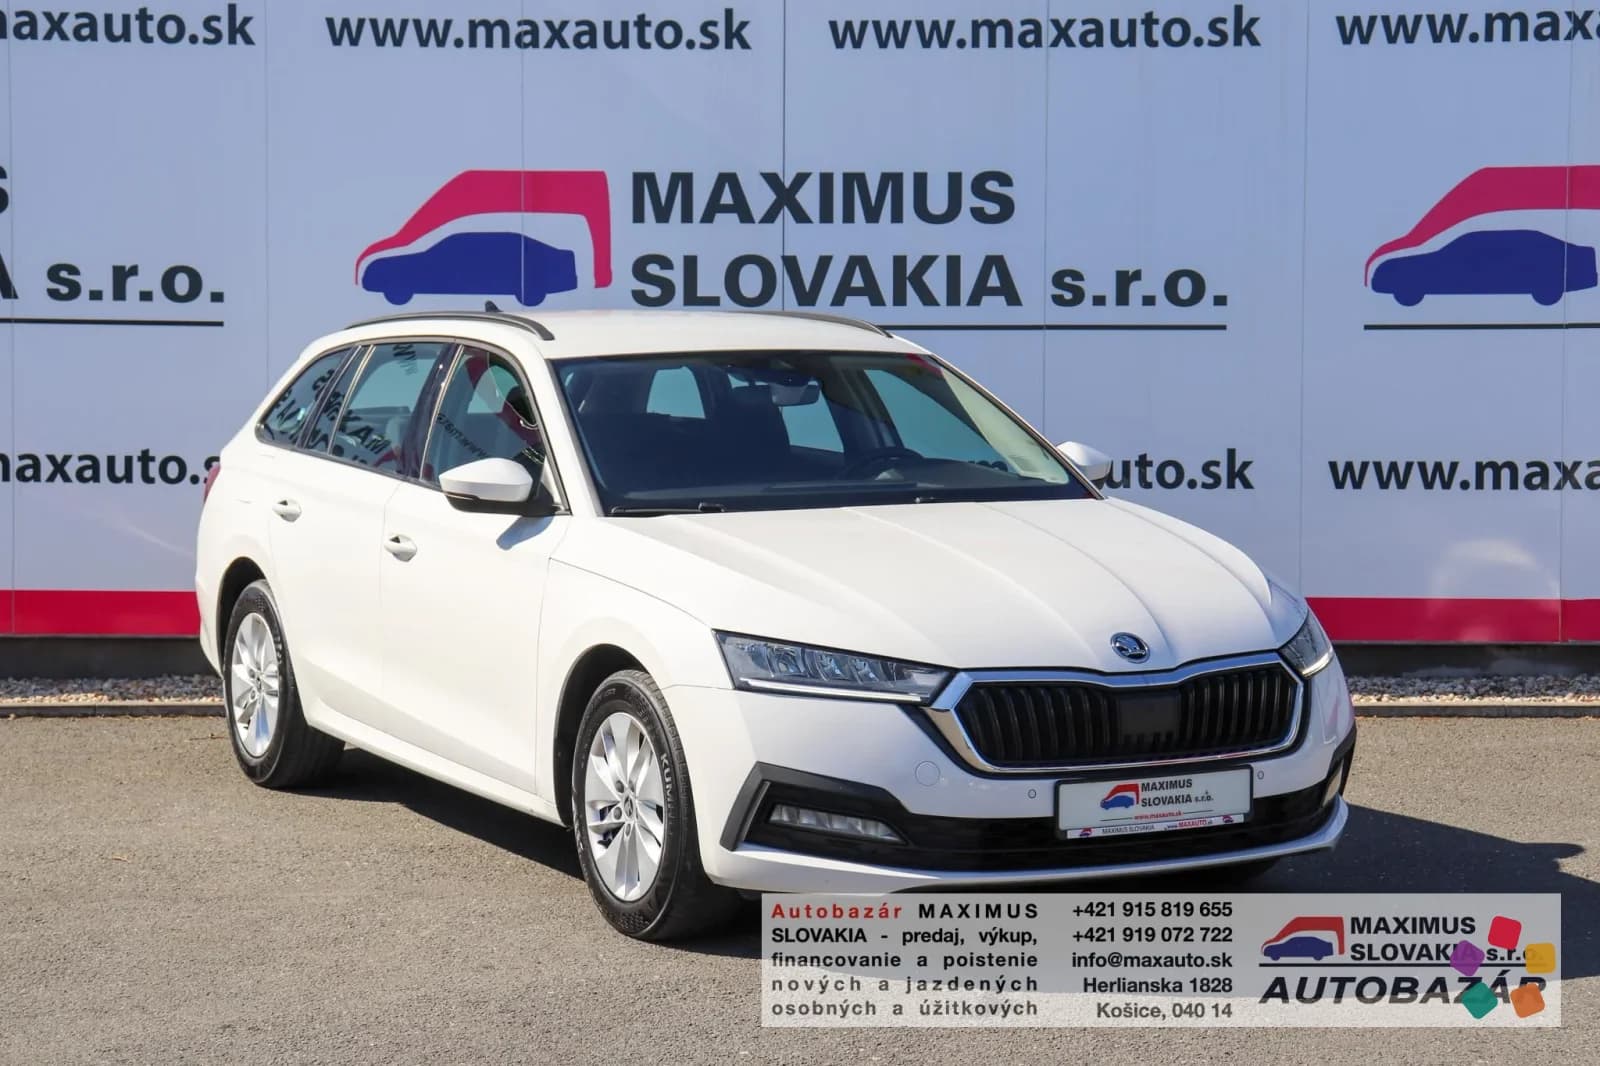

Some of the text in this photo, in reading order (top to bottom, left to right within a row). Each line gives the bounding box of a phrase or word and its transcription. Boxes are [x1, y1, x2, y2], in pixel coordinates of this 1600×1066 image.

[0, 4, 255, 45] axauto.sk
[326, 8, 751, 49] www.maxauto.sk
[829, 5, 1261, 49] www.maxauto.sk
[1336, 10, 1600, 45] www.max
[632, 171, 1015, 225] MAXIMUS
[47, 264, 223, 303] s.r.o.
[632, 255, 1227, 308] SLOVAKIA s.r.o.
[0, 449, 206, 484] axauto.
[1102, 448, 1254, 489] uto.sk
[1141, 779, 1193, 793] MAXIMUS
[1141, 794, 1192, 808] SLOVAKIA
